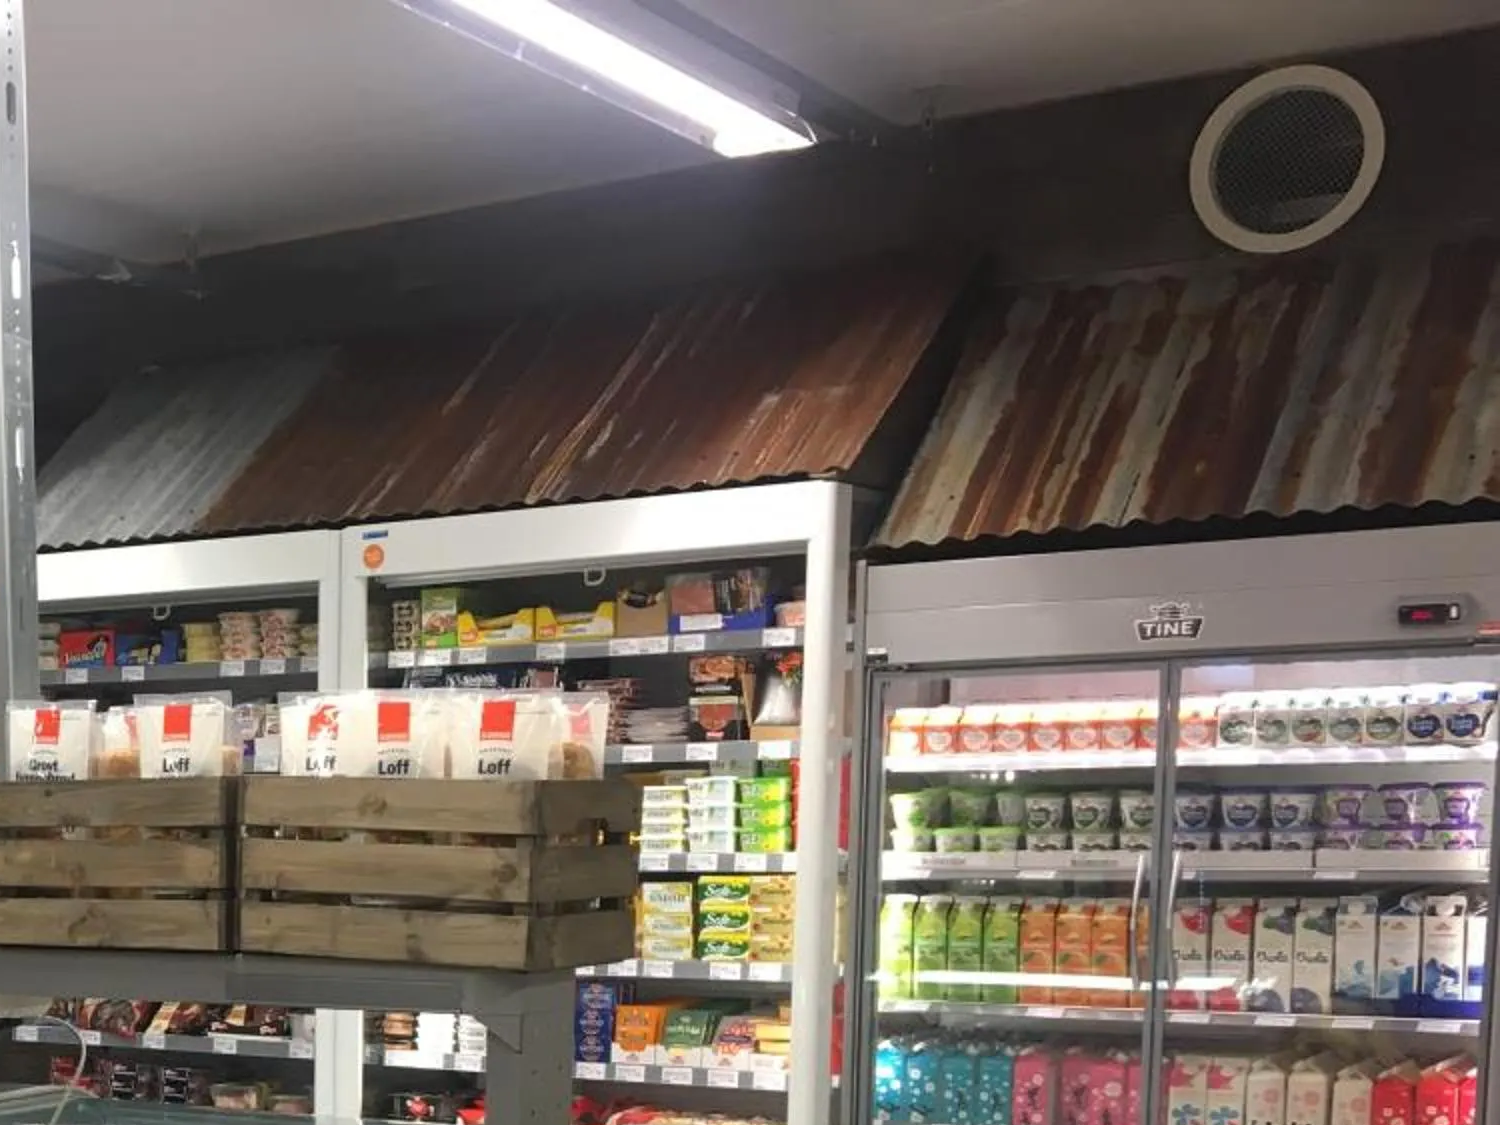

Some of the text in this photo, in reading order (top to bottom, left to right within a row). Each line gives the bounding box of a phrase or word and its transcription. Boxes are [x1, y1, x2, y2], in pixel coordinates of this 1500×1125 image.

[1142, 621, 1194, 637] TINE
[377, 758, 411, 775] Loff
[477, 757, 512, 775] Loff
